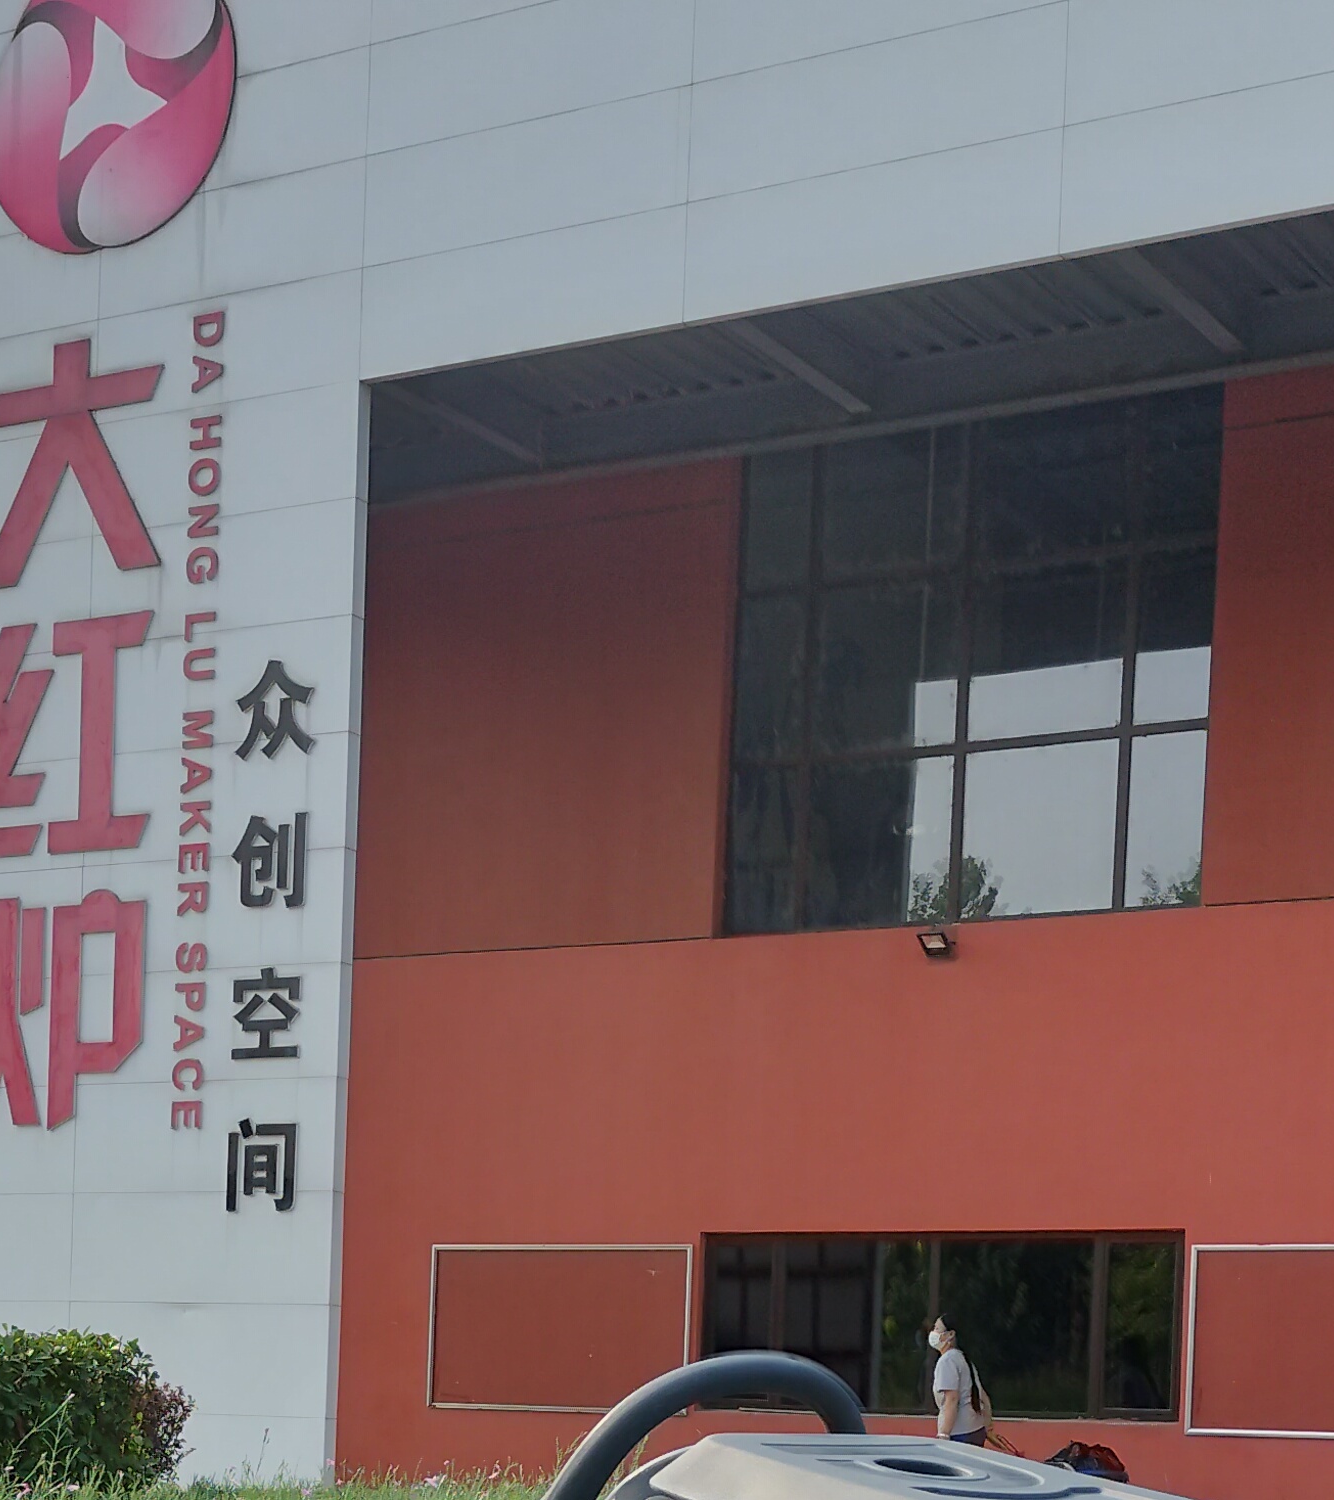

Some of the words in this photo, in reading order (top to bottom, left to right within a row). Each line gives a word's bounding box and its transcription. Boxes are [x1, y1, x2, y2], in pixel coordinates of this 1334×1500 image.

[191, 310, 225, 394] DA
[185, 414, 223, 587] HONG
[180, 611, 217, 683] LU
[176, 710, 214, 918] MAKER
[225, 659, 316, 1213] 众创空间
[170, 940, 208, 1132] SPACE
